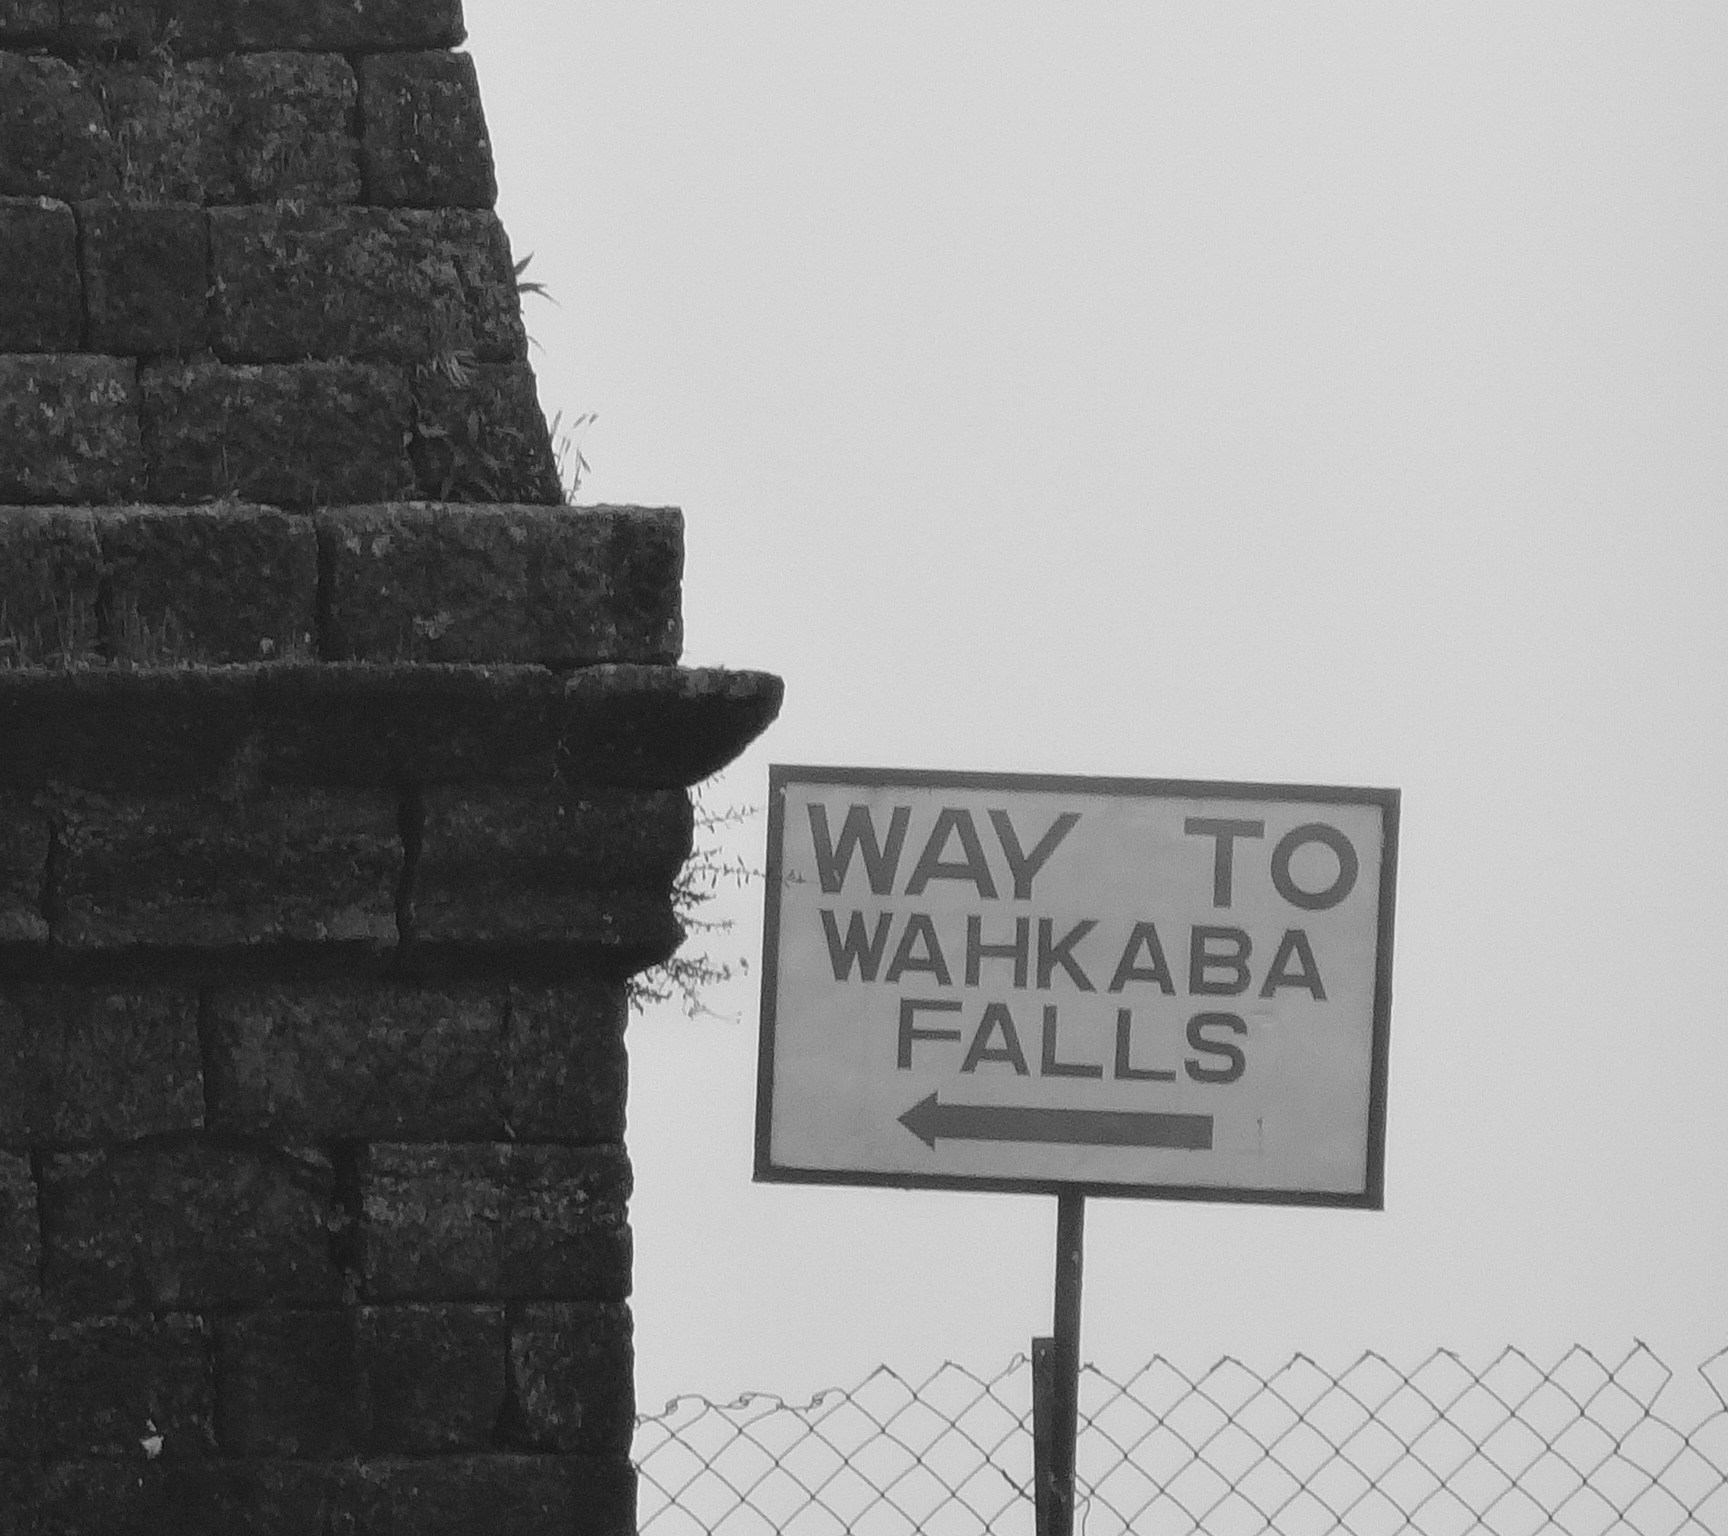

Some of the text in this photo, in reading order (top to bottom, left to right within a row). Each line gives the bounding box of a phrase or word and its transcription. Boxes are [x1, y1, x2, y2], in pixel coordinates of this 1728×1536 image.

[807, 803, 1359, 911] WAY TO
[820, 909, 1328, 1002] WAHKABA
[896, 997, 1248, 1084] FALLS
